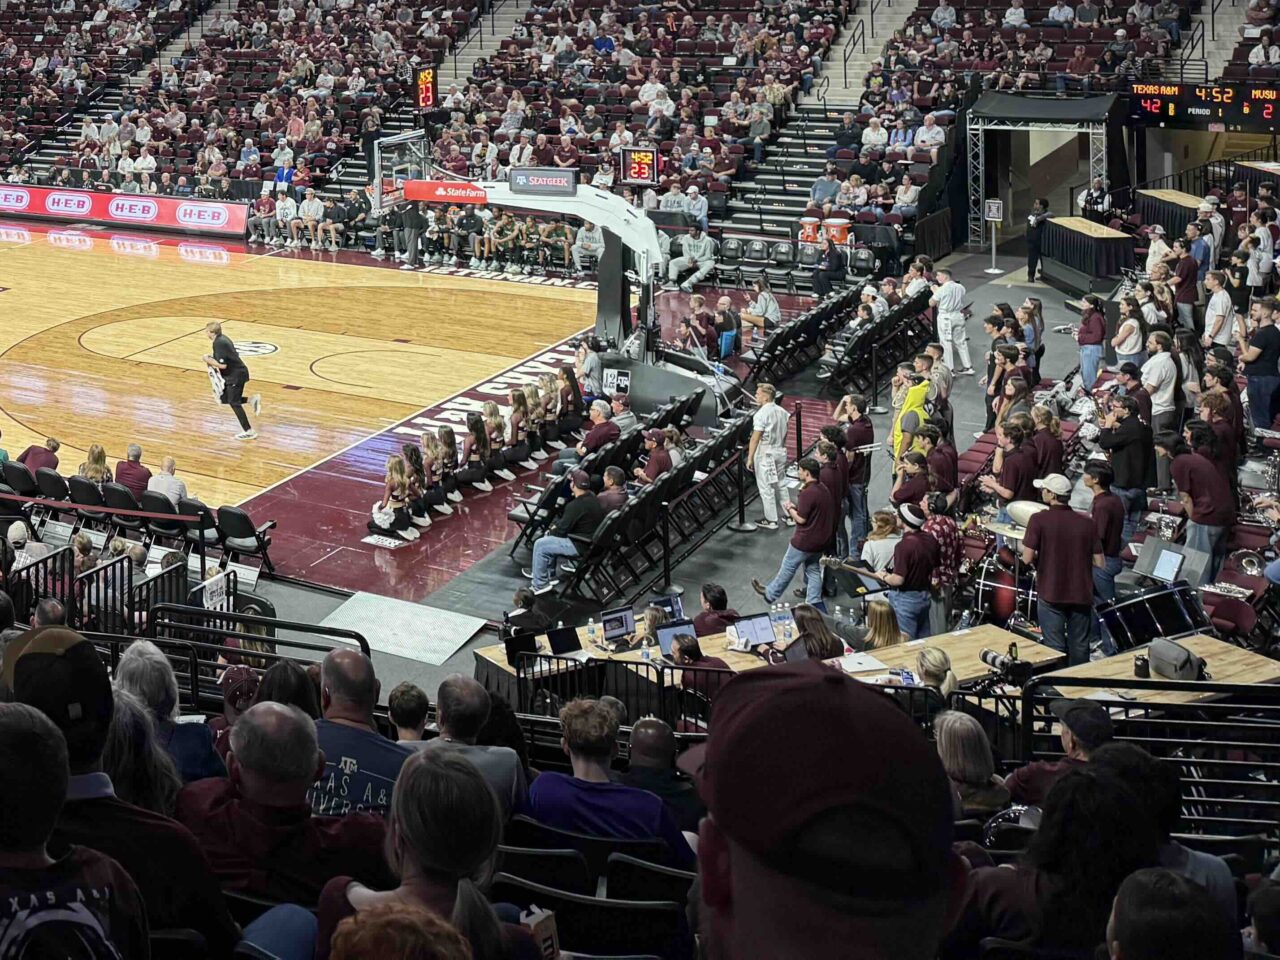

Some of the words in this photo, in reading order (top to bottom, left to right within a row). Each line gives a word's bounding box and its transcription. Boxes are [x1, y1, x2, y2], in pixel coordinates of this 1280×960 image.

[419, 83, 433, 107] 23
[1132, 84, 1159, 95] TEXAS
[1160, 85, 1179, 96] A&M
[1195, 87, 1233, 103] 4:52
[1251, 89, 1277, 100] MVSU
[1141, 99, 1161, 113] 42
[1187, 107, 1211, 116] PERIOD
[631, 151, 653, 164] 4:52
[630, 163, 649, 178] 23
[528, 177, 568, 186] SEATGEEK
